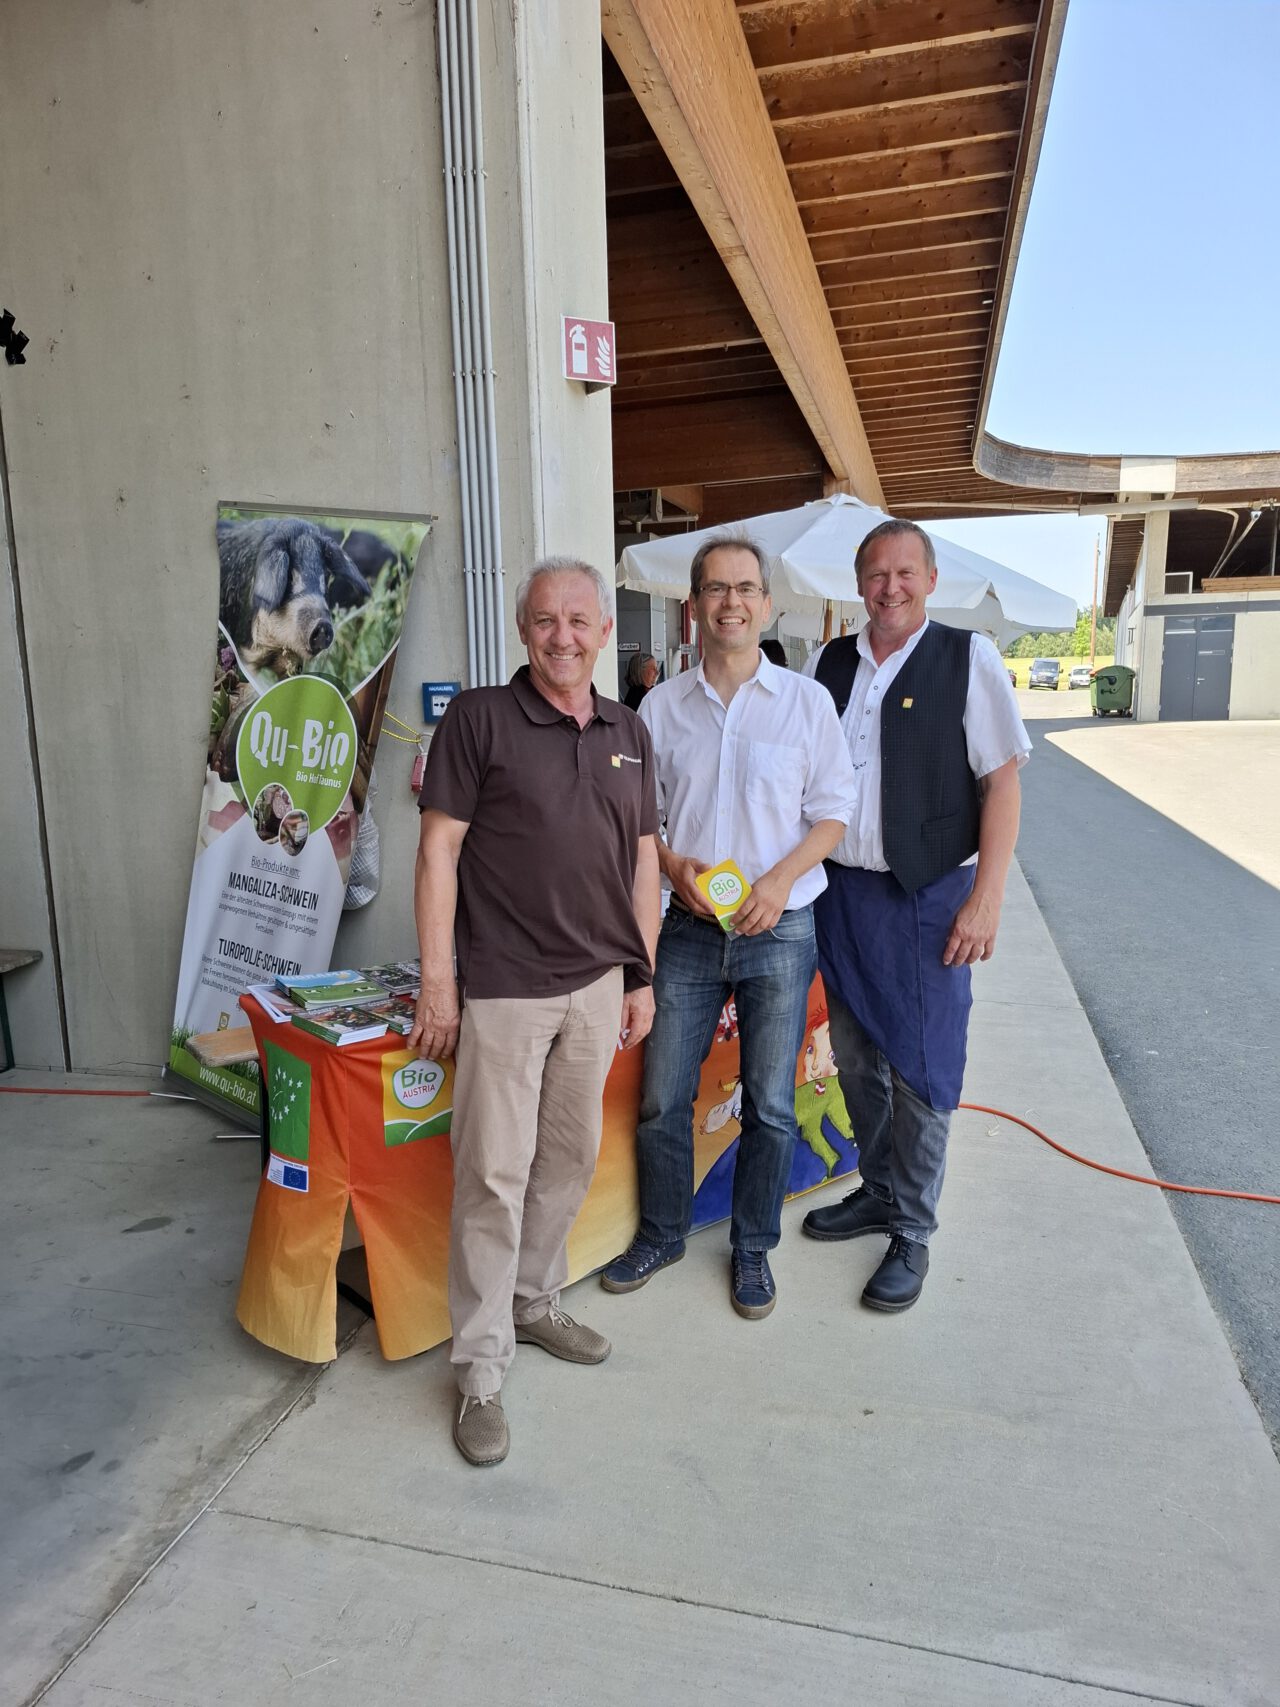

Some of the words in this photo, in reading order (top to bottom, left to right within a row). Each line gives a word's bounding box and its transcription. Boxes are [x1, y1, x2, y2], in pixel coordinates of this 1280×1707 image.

[250, 711, 349, 774] Qu-Bio
[296, 771, 307, 783] Bio
[319, 774, 342, 788] Taunus
[251, 856, 289, 875] Bio-Produkte
[228, 872, 319, 911] MANGALIZA-SCHWEIN
[711, 879, 736, 896] Bio
[297, 913, 306, 921] mit
[218, 938, 302, 976] TUROPOLJE-SCHWEIN
[200, 1066, 257, 1105] www.qu-bio.at
[401, 1068, 437, 1088] Bio
[402, 1084, 436, 1099] AUSTRIA
